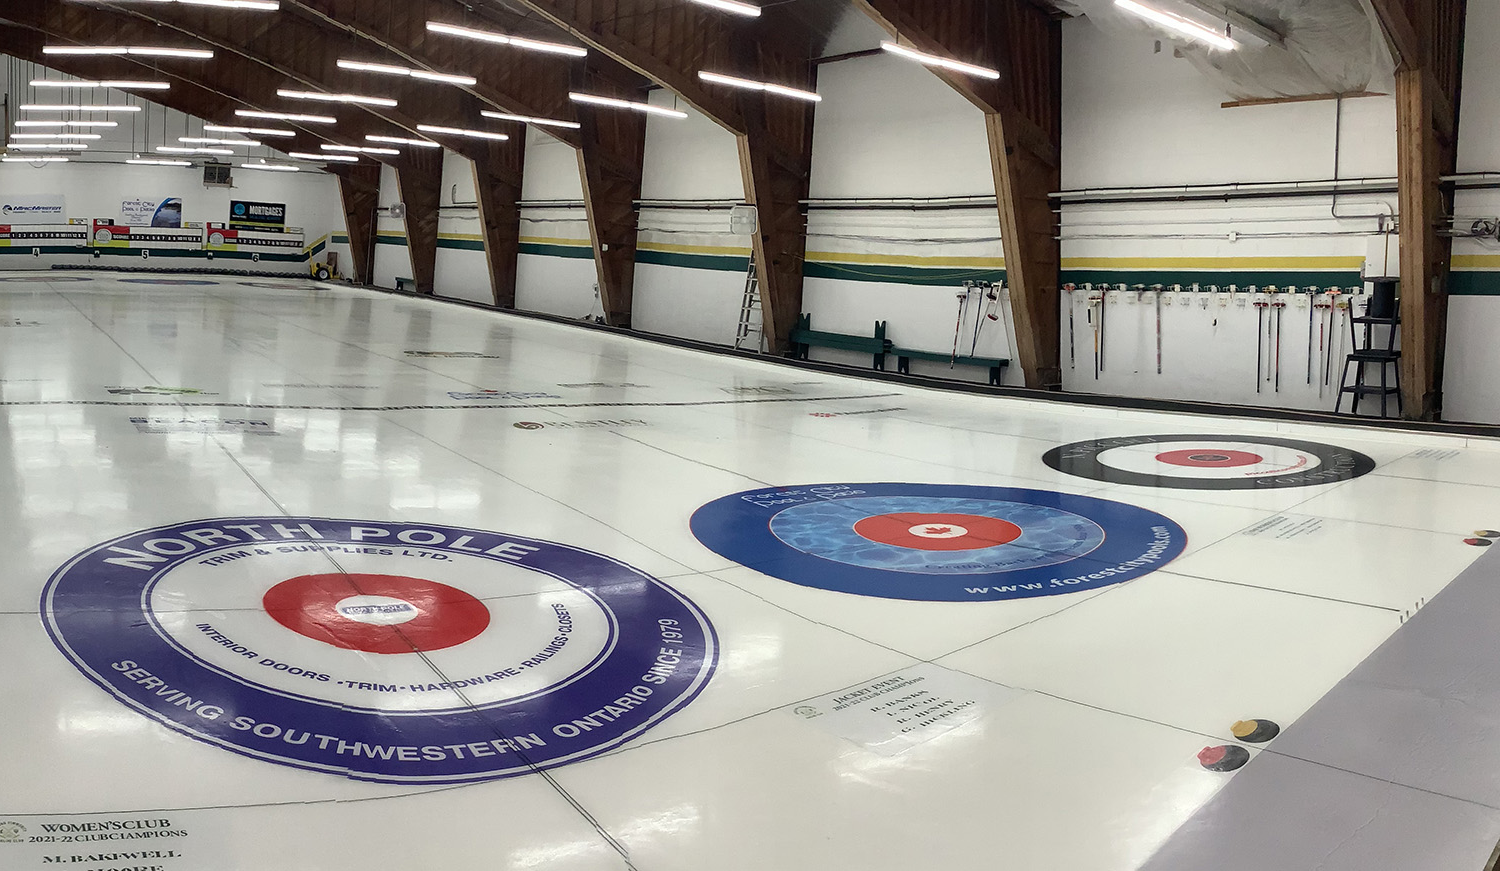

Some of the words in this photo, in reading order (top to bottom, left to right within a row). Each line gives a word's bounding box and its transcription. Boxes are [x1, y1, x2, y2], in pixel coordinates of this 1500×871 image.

[250, 205, 283, 216] MORTGAGES
[103, 524, 324, 571] NORTH
[350, 526, 540, 562] POLE
[199, 549, 252, 568] TRIM
[254, 547, 272, 556] &
[279, 545, 394, 556] SUPPLIES
[402, 549, 454, 563] LTD.
[658, 618, 684, 644] 1979
[196, 622, 258, 659] INTERIOR
[259, 658, 332, 682] DOORS
[344, 680, 398, 692] TRIM
[409, 667, 520, 693] HARDWARE
[522, 635, 569, 669] RAILINGS
[551, 603, 574, 633] CLOSETS
[642, 647, 683, 685] SINCE
[111, 660, 224, 720] SERVING
[833, 688, 871, 704] JACKET
[871, 676, 904, 690] EVENT
[552, 685, 654, 739] ONTARIO
[229, 716, 547, 762] SOUTHWESTERN
[41, 820, 128, 833] WOMEN'S
[128, 819, 171, 830] CLUB
[75, 834, 108, 842] CLUB
